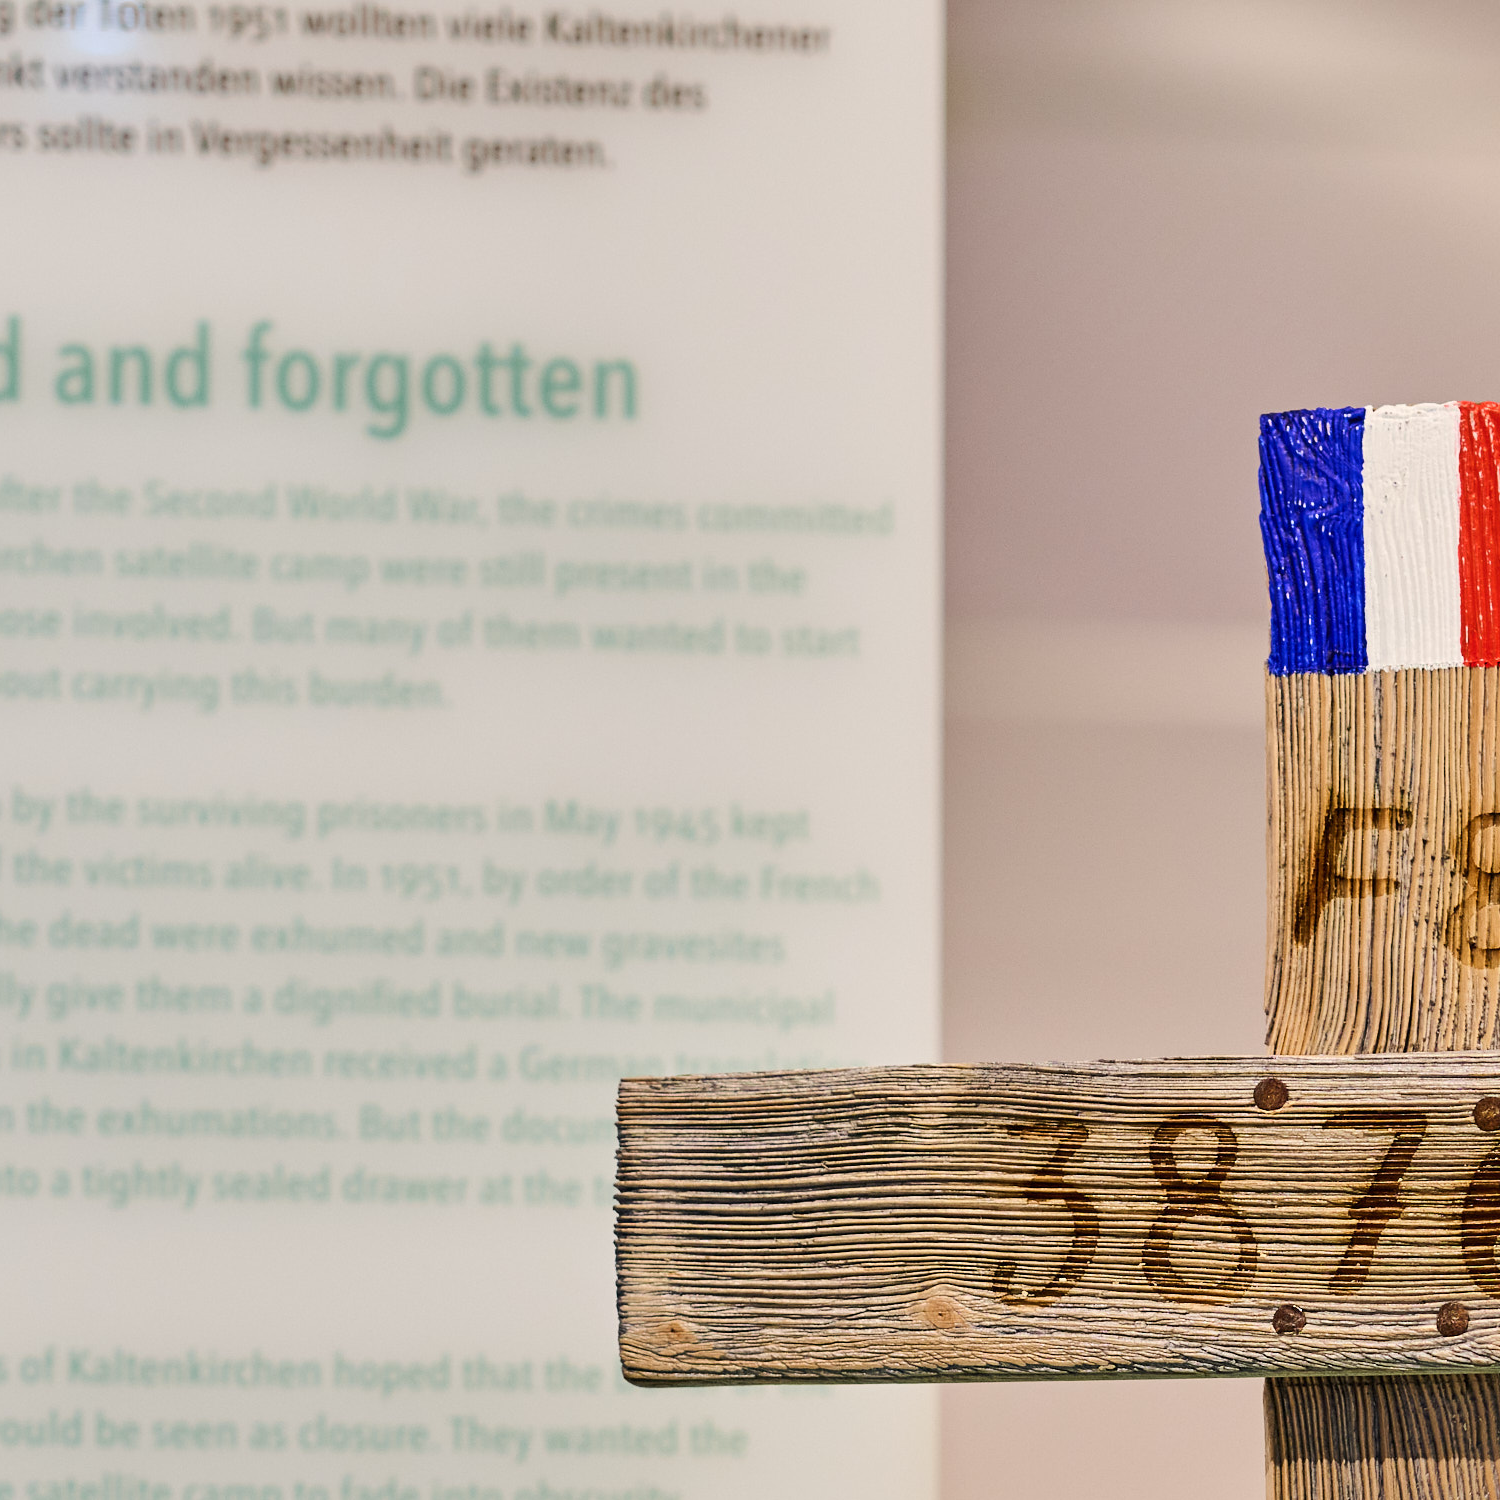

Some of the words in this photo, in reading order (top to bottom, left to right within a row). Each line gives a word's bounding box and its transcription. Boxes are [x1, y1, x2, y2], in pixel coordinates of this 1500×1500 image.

[53, 62, 260, 94] verstanden
[412, 67, 475, 102] Die
[483, 69, 635, 106] Existenz
[643, 79, 709, 110] des
[38, 118, 138, 153] sollte
[146, 128, 185, 153] in
[191, 128, 454, 171] Vergessenheit
[54, 322, 215, 407] and
[242, 328, 640, 440] forgotten
[71, 479, 134, 516] the
[141, 481, 280, 519] Second
[284, 486, 400, 522] World
[496, 491, 557, 528] the
[565, 499, 689, 531] crimes
[695, 499, 896, 536] committed
[113, 543, 260, 581] satellite
[269, 554, 372, 591] camp
[379, 557, 469, 586] were
[478, 550, 548, 588] still
[552, 560, 693, 599] present
[700, 562, 741, 593] in
[745, 559, 809, 596] the
[250, 605, 316, 645] But
[324, 617, 429, 656] many
[434, 611, 475, 649] of
[481, 614, 582, 652] them
[590, 617, 728, 655] wanted
[779, 626, 862, 660] start
[70, 673, 222, 714] carrying
[229, 669, 300, 707] this
[10, 789, 57, 832] by
[63, 788, 126, 826] the
[133, 797, 309, 839] surviving
[315, 801, 489, 842] prisoners
[497, 803, 535, 834] in
[542, 800, 622, 844] May
[632, 808, 722, 845] 1945
[728, 805, 811, 847] kept
[11, 849, 74, 886] the
[83, 857, 215, 889] victims
[329, 857, 368, 891] In
[480, 860, 526, 905] by
[535, 861, 634, 898] order
[642, 861, 682, 900] of
[688, 866, 751, 901] the
[756, 865, 882, 904] French
[48, 912, 142, 951] dead
[149, 924, 240, 952] were
[249, 918, 427, 956] exhumed
[434, 921, 506, 958] and
[514, 931, 593, 959] new
[600, 929, 787, 974] gravesites
[44, 983, 125, 1021] give
[134, 977, 233, 1014] them
[273, 978, 443, 1029] dignified
[579, 984, 643, 1022] The
[651, 988, 838, 1033] municipal
[10, 1043, 48, 1071] in
[56, 1040, 313, 1075] Kaltenkirchen
[322, 1044, 480, 1080] received
[24, 1098, 87, 1135] the
[357, 1105, 423, 1142] But
[430, 1106, 491, 1143] the
[80, 1163, 202, 1210] tightly
[210, 1164, 332, 1204] sealed
[340, 1168, 469, 1205] drawer
[476, 1173, 515, 1207] at
[522, 1170, 581, 1208] the
[17, 1346, 58, 1384] of
[65, 1351, 323, 1387] Kaltenkirchen
[332, 1352, 453, 1398] hoped
[459, 1354, 536, 1392] that
[543, 1355, 606, 1394] the
[93, 1412, 141, 1448] be
[150, 1421, 238, 1450] seen
[248, 1422, 288, 1451] as
[450, 1417, 534, 1462] They
[542, 1421, 681, 1456] wanted
[687, 1420, 749, 1458] the
